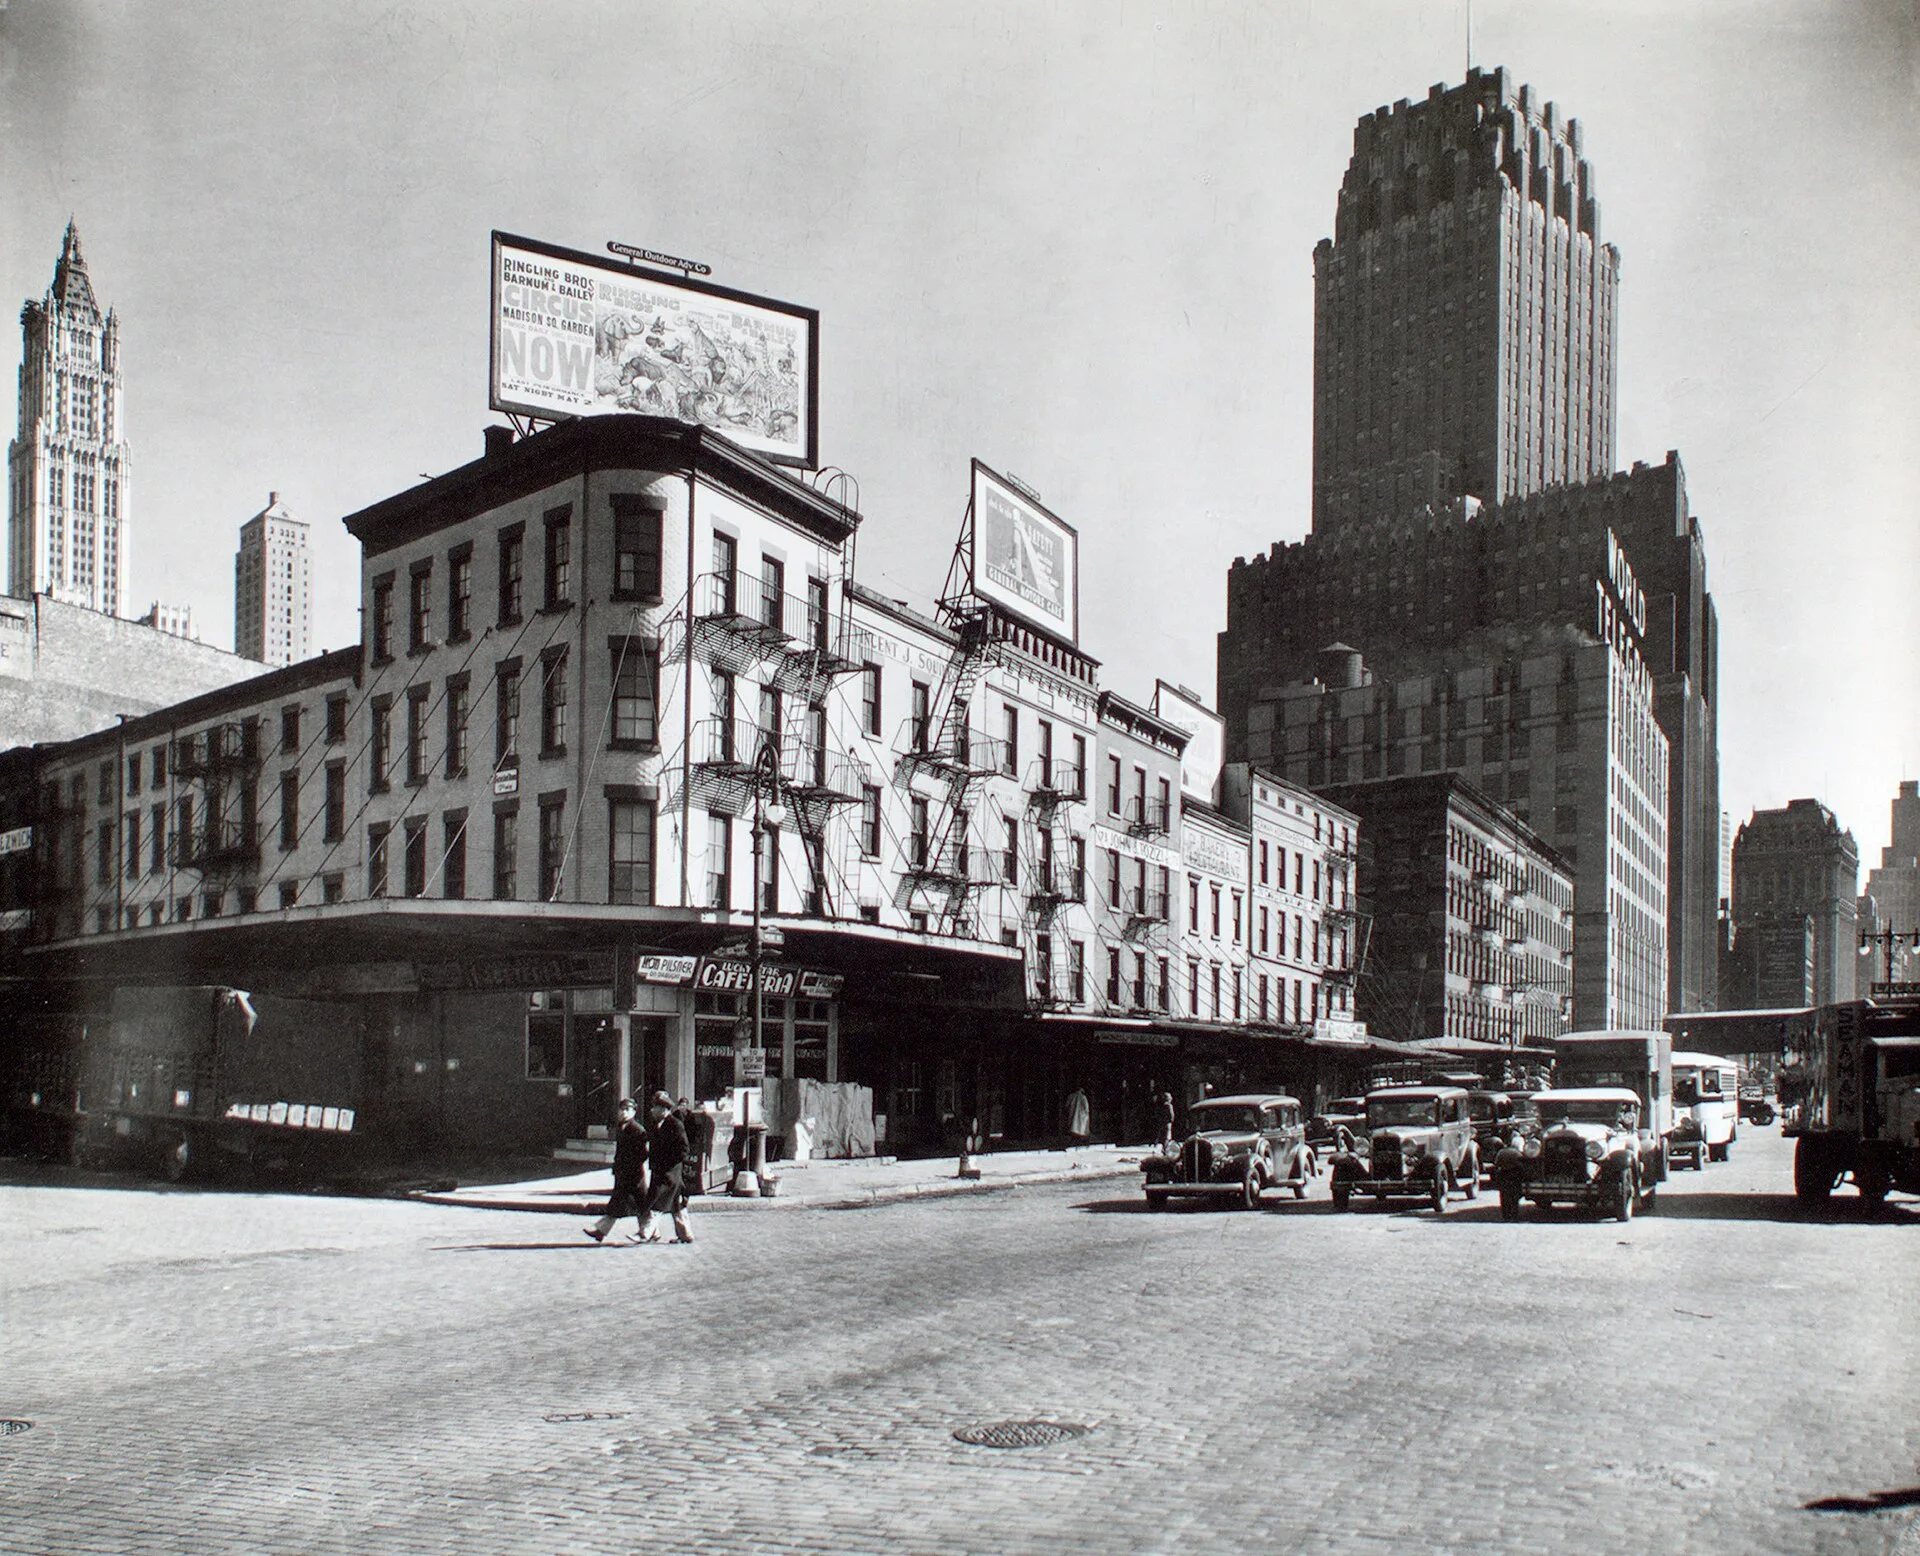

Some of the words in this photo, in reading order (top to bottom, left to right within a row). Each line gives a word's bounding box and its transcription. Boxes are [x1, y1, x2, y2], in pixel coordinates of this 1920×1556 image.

[612, 242, 643, 258] General
[645, 251, 676, 265] Outdoor
[678, 259, 694, 270] Adv
[503, 258, 559, 279] RINGLING
[564, 271, 595, 291] BROS
[503, 271, 549, 291] BARNUM
[559, 284, 595, 302] BAILEY
[504, 284, 594, 323] CIRCUS
[599, 283, 680, 311] RINGLING
[502, 306, 543, 326] MADISON
[561, 319, 595, 337] GARDEN
[502, 328, 594, 391] NOW
[502, 382, 519, 391] SAT
[524, 387, 554, 398] NIGHT
[557, 394, 579, 404] MAY
[1607, 526, 1646, 638] WORLD
[661, 958, 693, 974] PILSNER
[702, 964, 794, 993] CAFETERIA
[722, 962, 751, 973] LUCKY
